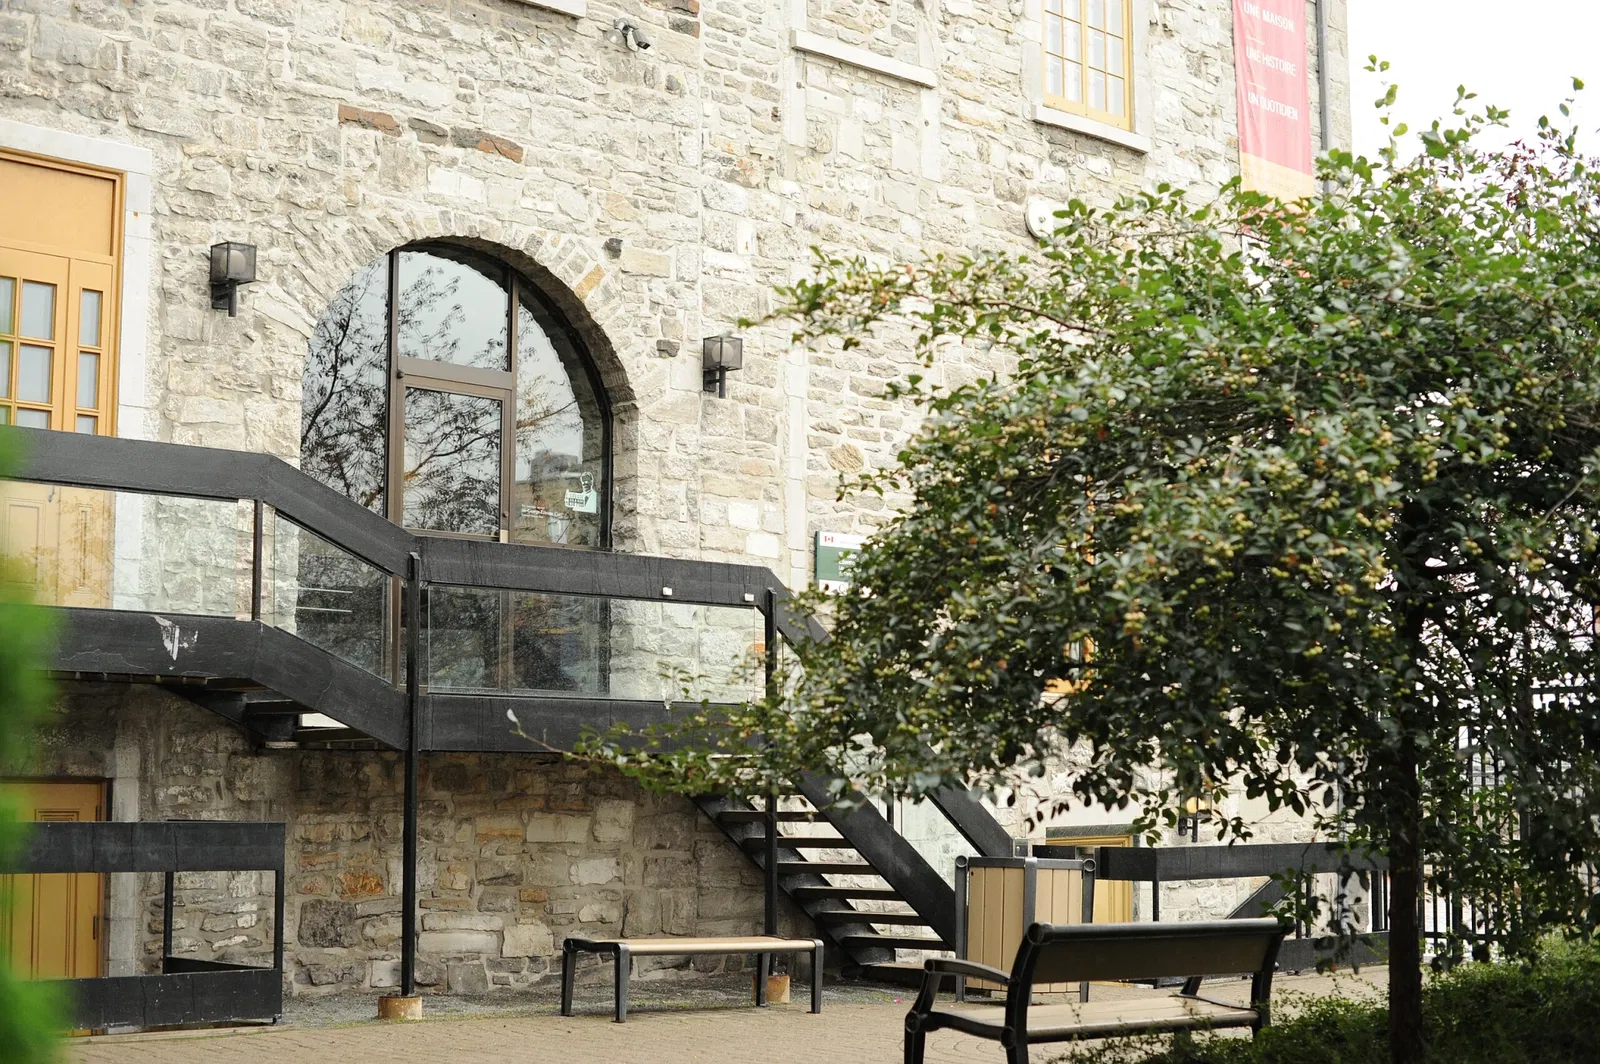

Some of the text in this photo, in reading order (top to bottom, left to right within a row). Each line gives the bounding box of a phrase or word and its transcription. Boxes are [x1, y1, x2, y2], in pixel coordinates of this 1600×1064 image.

[1243, 1, 1295, 33] UNE MAISON
[1245, 46, 1297, 77] UNE HISTOIRE
[1247, 91, 1298, 120] UN QUOTIDIEN
